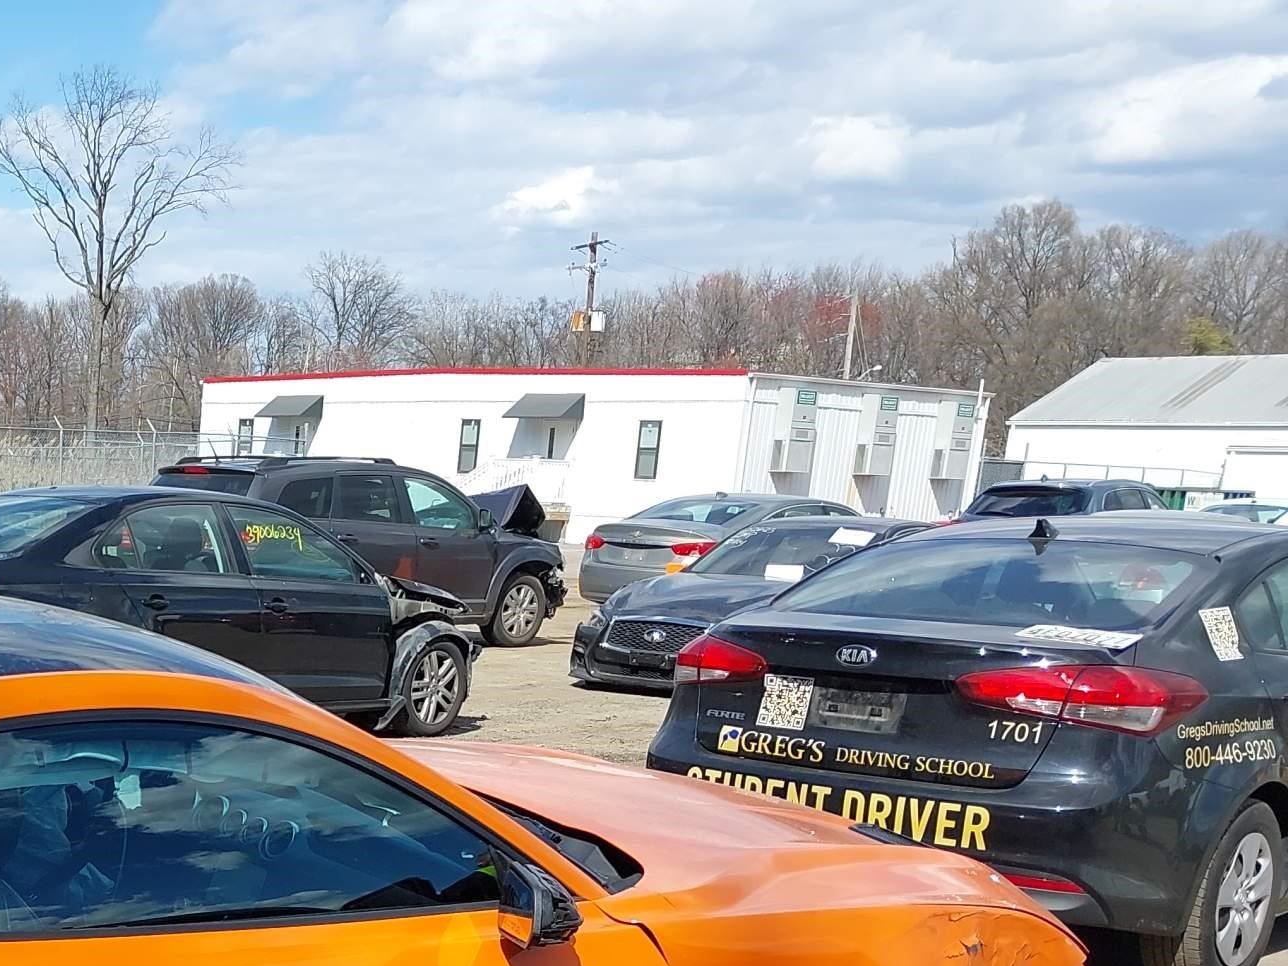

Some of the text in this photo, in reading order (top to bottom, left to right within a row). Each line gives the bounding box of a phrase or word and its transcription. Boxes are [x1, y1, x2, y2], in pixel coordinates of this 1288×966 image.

[841, 648, 868, 662] KIA
[706, 709, 746, 720] FORTE
[988, 720, 1043, 744] 1701
[1177, 716, 1274, 740] GregsDrivingSchool.net
[741, 731, 995, 779] GREG'S DRIVING SCHOOL
[1185, 739, 1276, 769] 800-446-9230
[842, 789, 991, 851] DRIVER
